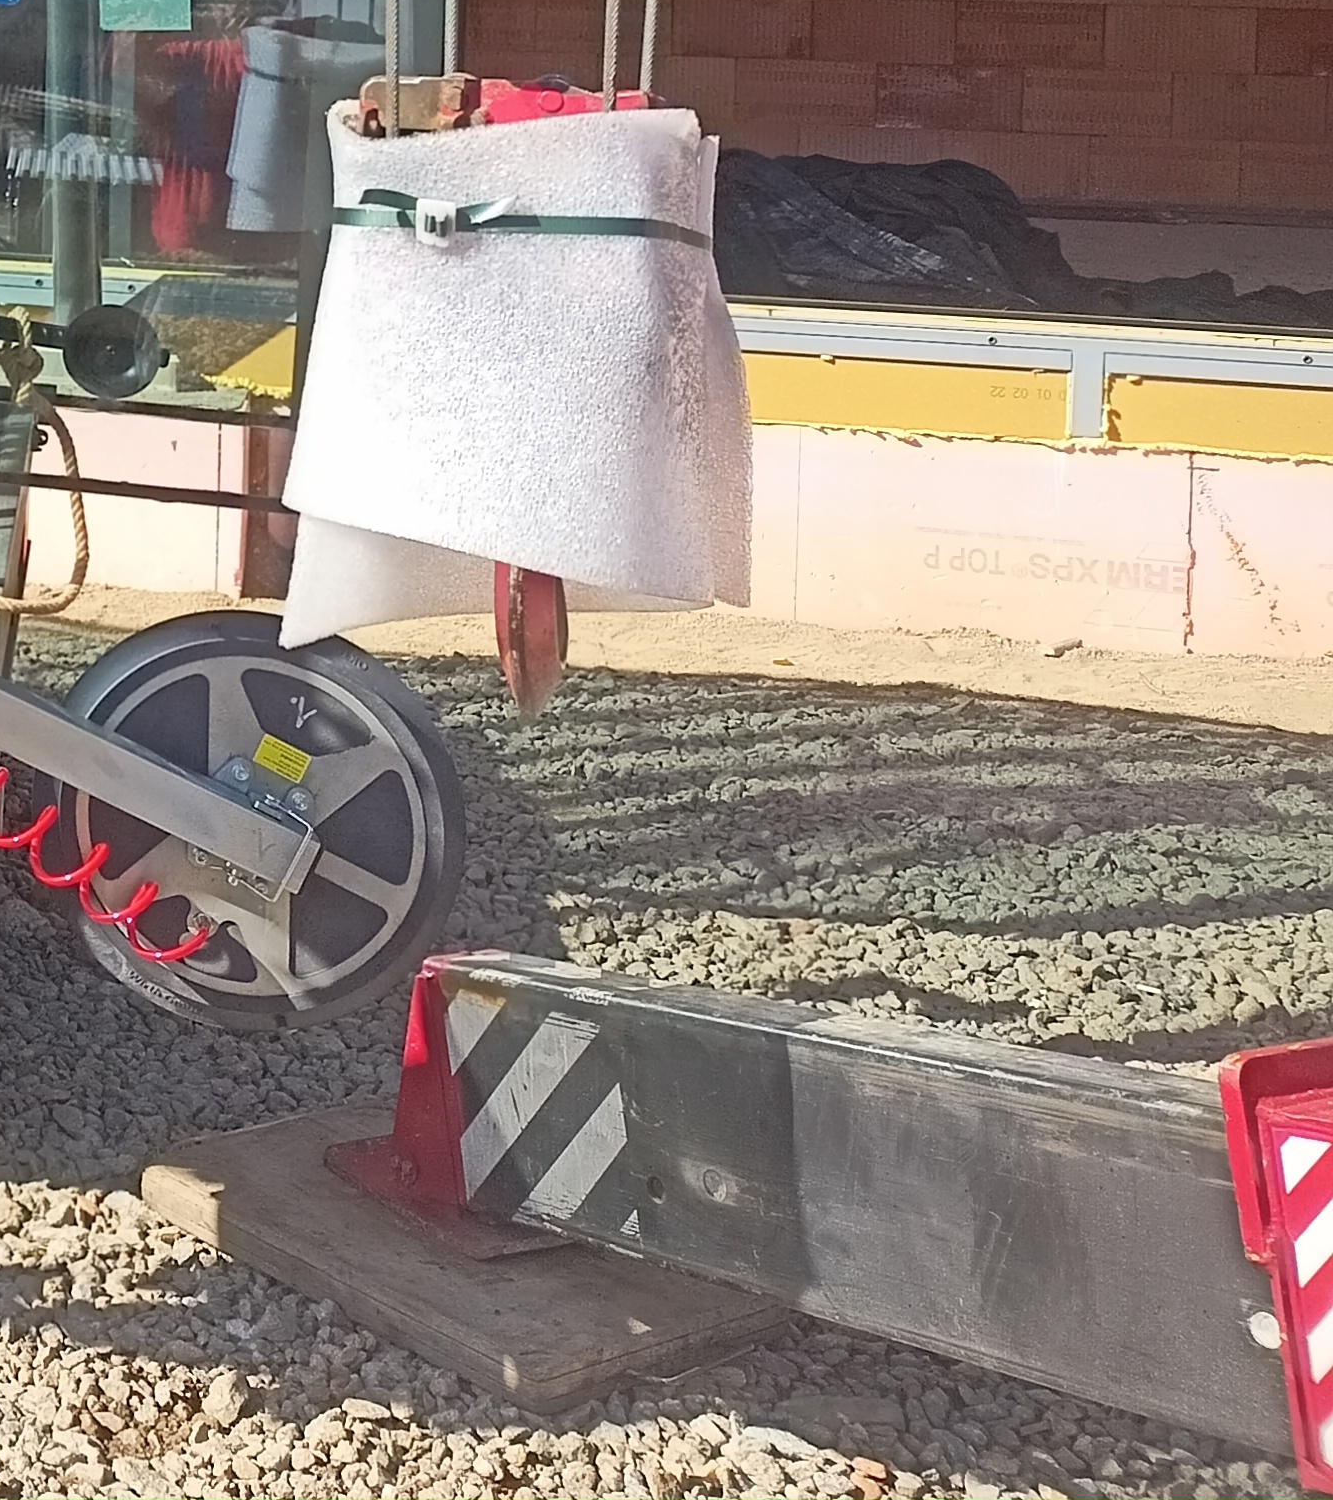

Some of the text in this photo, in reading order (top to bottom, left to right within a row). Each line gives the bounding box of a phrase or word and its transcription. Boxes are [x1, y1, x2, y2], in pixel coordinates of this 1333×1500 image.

[989, 385, 1006, 398] 22
[1012, 387, 1029, 400] 02
[923, 544, 940, 570] P
[948, 547, 1006, 577] TOP
